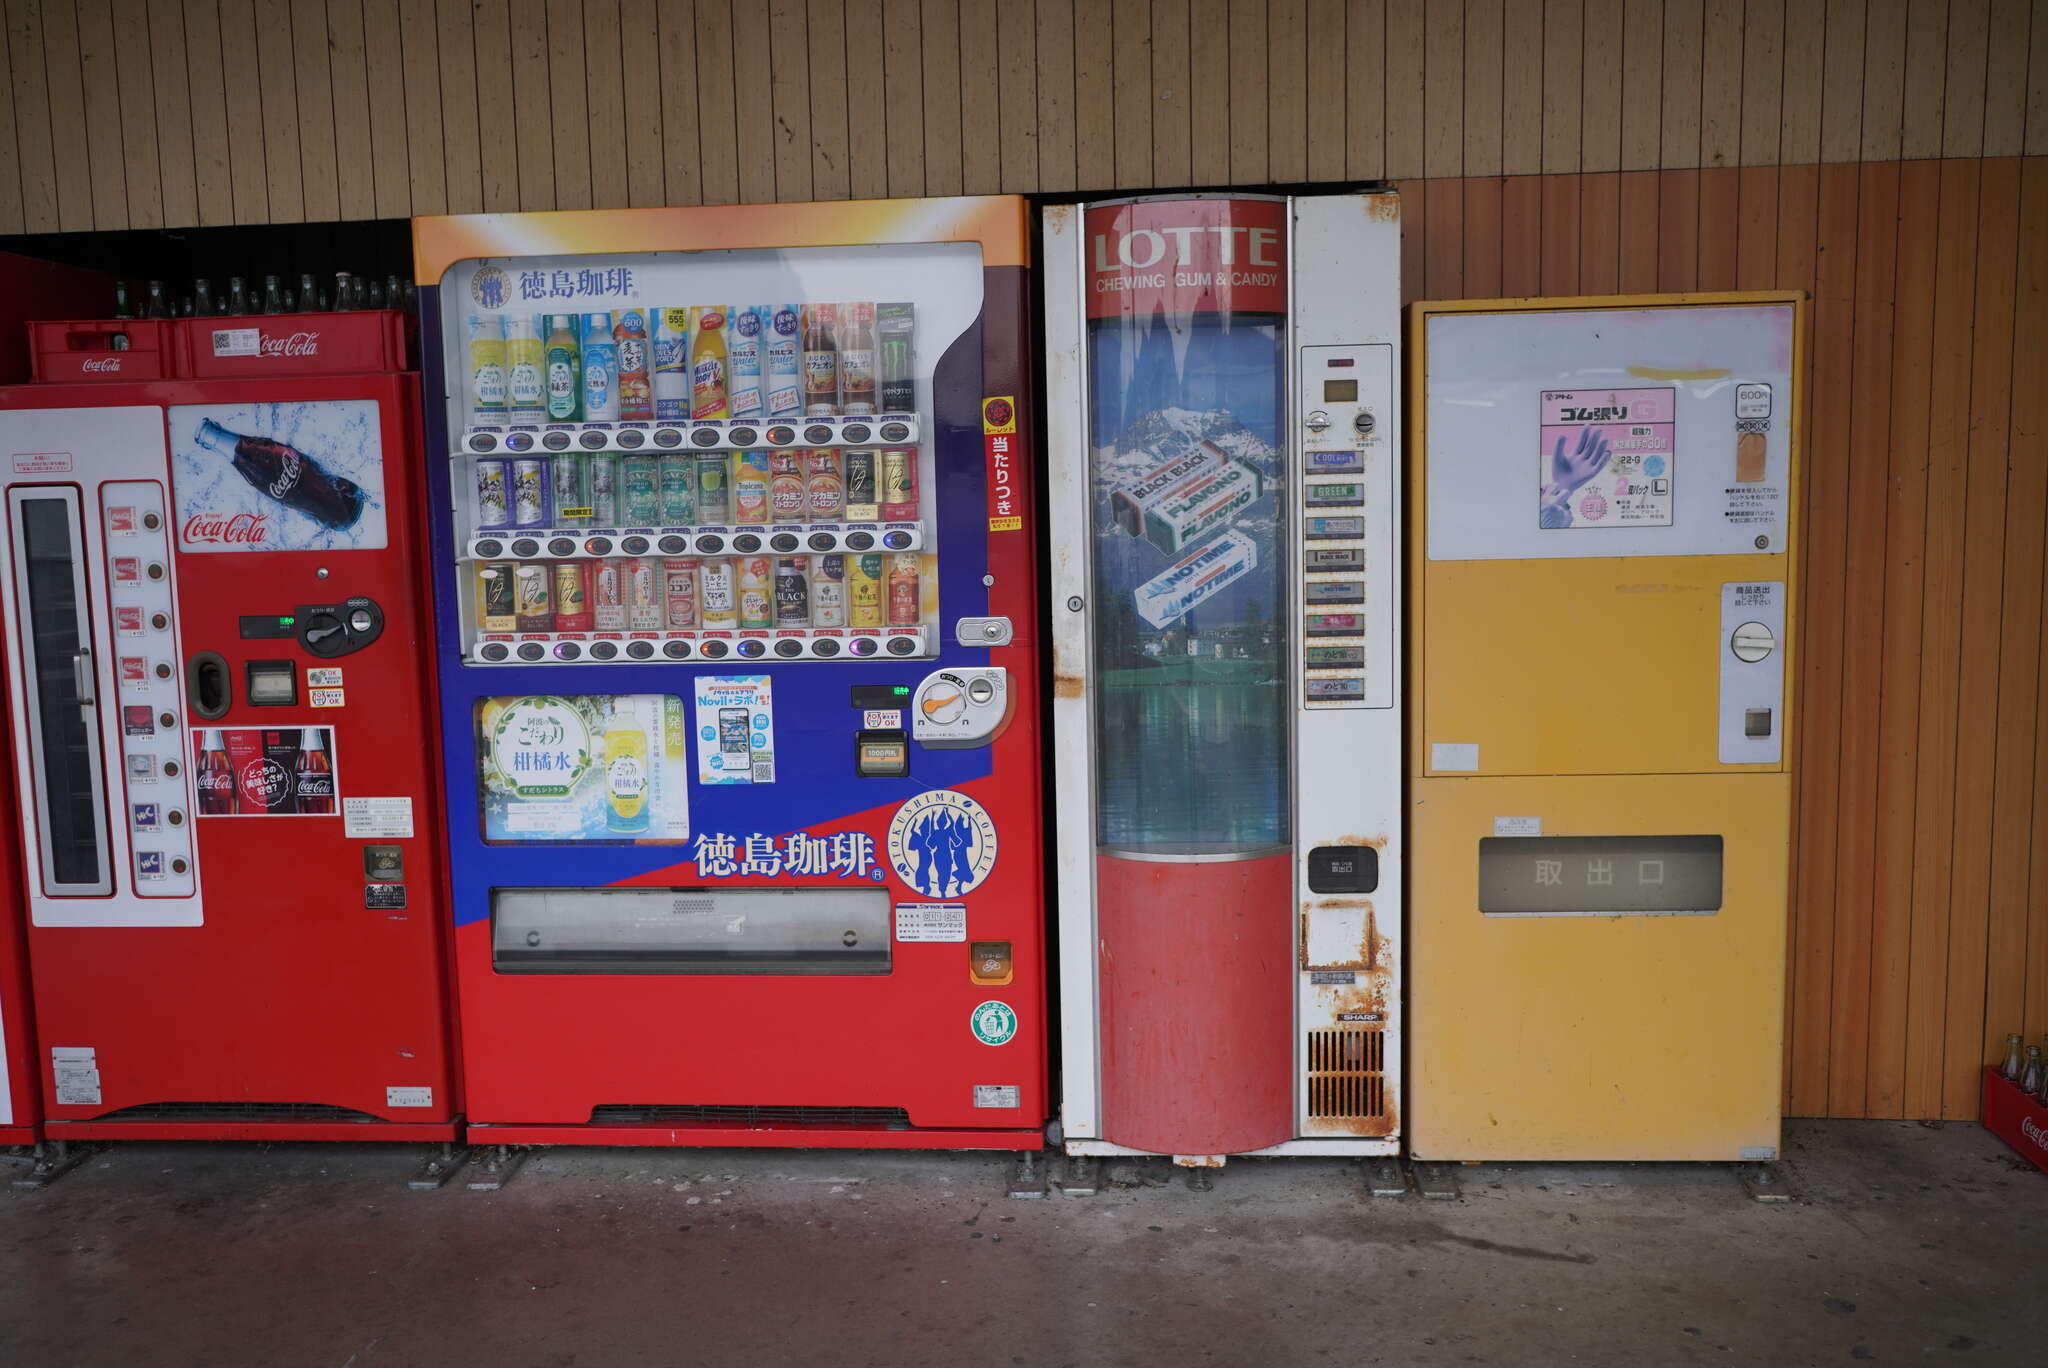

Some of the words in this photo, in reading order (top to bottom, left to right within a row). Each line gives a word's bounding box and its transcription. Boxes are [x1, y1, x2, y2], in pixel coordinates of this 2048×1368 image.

[1095, 227, 1279, 272] LOTTE
[520, 268, 634, 300] 徳島珈琲
[1096, 272, 1165, 292] CHEWING
[1175, 272, 1212, 287] GUM
[1216, 272, 1227, 286] &
[1231, 271, 1278, 287] CANDY
[624, 319, 642, 327] 600
[82, 358, 121, 372] Coca-Cola
[1560, 406, 1628, 421] ゴム張り
[1619, 455, 1641, 464] 22-G
[268, 450, 302, 499] Coca-Cola
[992, 436, 1012, 515] 当たりつき
[1132, 475, 1173, 500] BLACK
[1170, 453, 1209, 478] BLACK
[1166, 470, 1242, 519] FLAVONO
[1318, 486, 1348, 497] GREEN
[1653, 480, 1667, 493] L
[1180, 490, 1251, 543] FLAVONO
[183, 513, 269, 544] Coca-Cola
[1168, 540, 1236, 586] NOTIME
[1180, 560, 1246, 609] NOTIME
[776, 592, 807, 601] BLACK
[698, 696, 728, 706] Novil
[666, 698, 683, 746] 新発売
[519, 725, 564, 745] こだわり
[513, 751, 571, 771] 柑橘水
[197, 774, 233, 790] Coca-Cola
[248, 766, 277, 778] どっちの
[297, 780, 331, 794] Coca-Cola
[890, 792, 957, 859] TOKUSHIMA
[975, 810, 994, 873] COFFEE
[692, 832, 876, 877] 徳島珈琲
[1535, 859, 1665, 887] 取出口
[1342, 1013, 1378, 1022] SHARP
